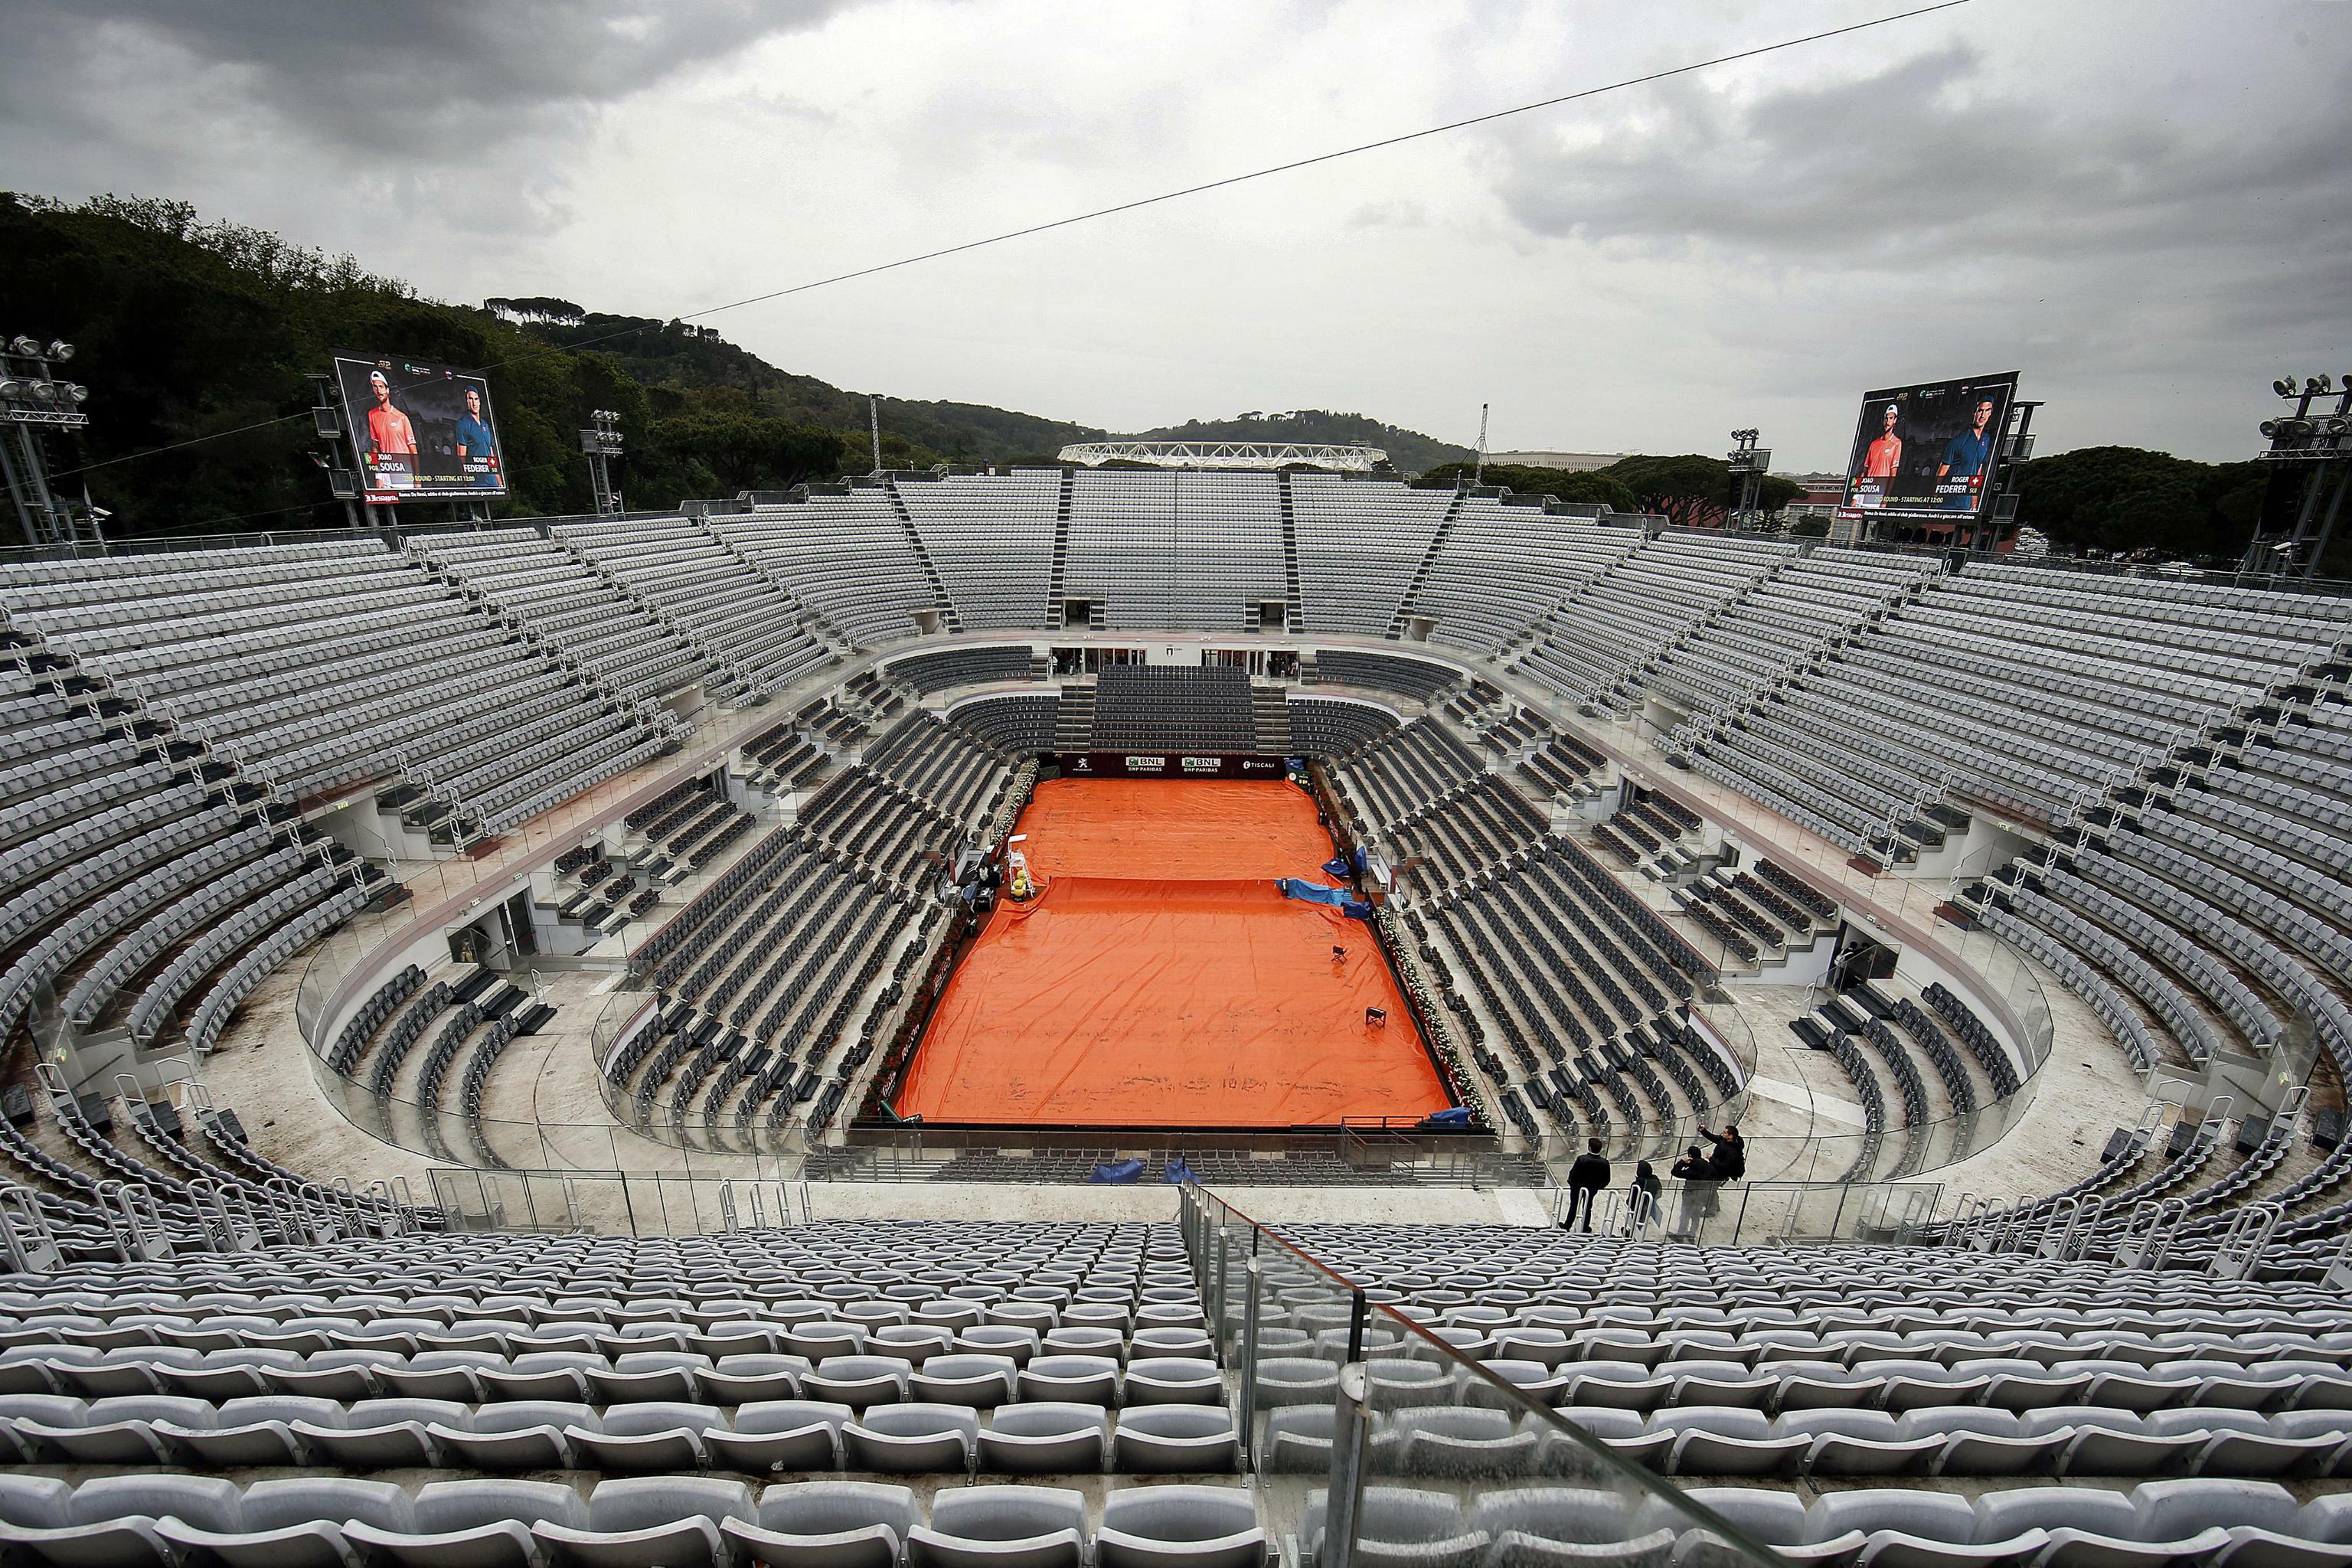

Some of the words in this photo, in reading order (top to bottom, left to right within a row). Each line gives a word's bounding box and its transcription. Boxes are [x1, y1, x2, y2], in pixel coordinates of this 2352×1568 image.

[380, 462, 406, 472] SOUSA
[463, 464, 490, 472] FEDERER
[1859, 485, 1880, 493] SOUSA
[1935, 485, 1967, 494] FEDERER
[348, 1215, 358, 1228] 04
[404, 1213, 413, 1223] 03
[209, 1223, 224, 1240] 06
[285, 1220, 297, 1234] 05
[1952, 1227, 1962, 1240] 03
[2007, 1230, 2019, 1246] 04
[2071, 1236, 2085, 1250] 05
[2148, 1242, 2162, 1257] 06
